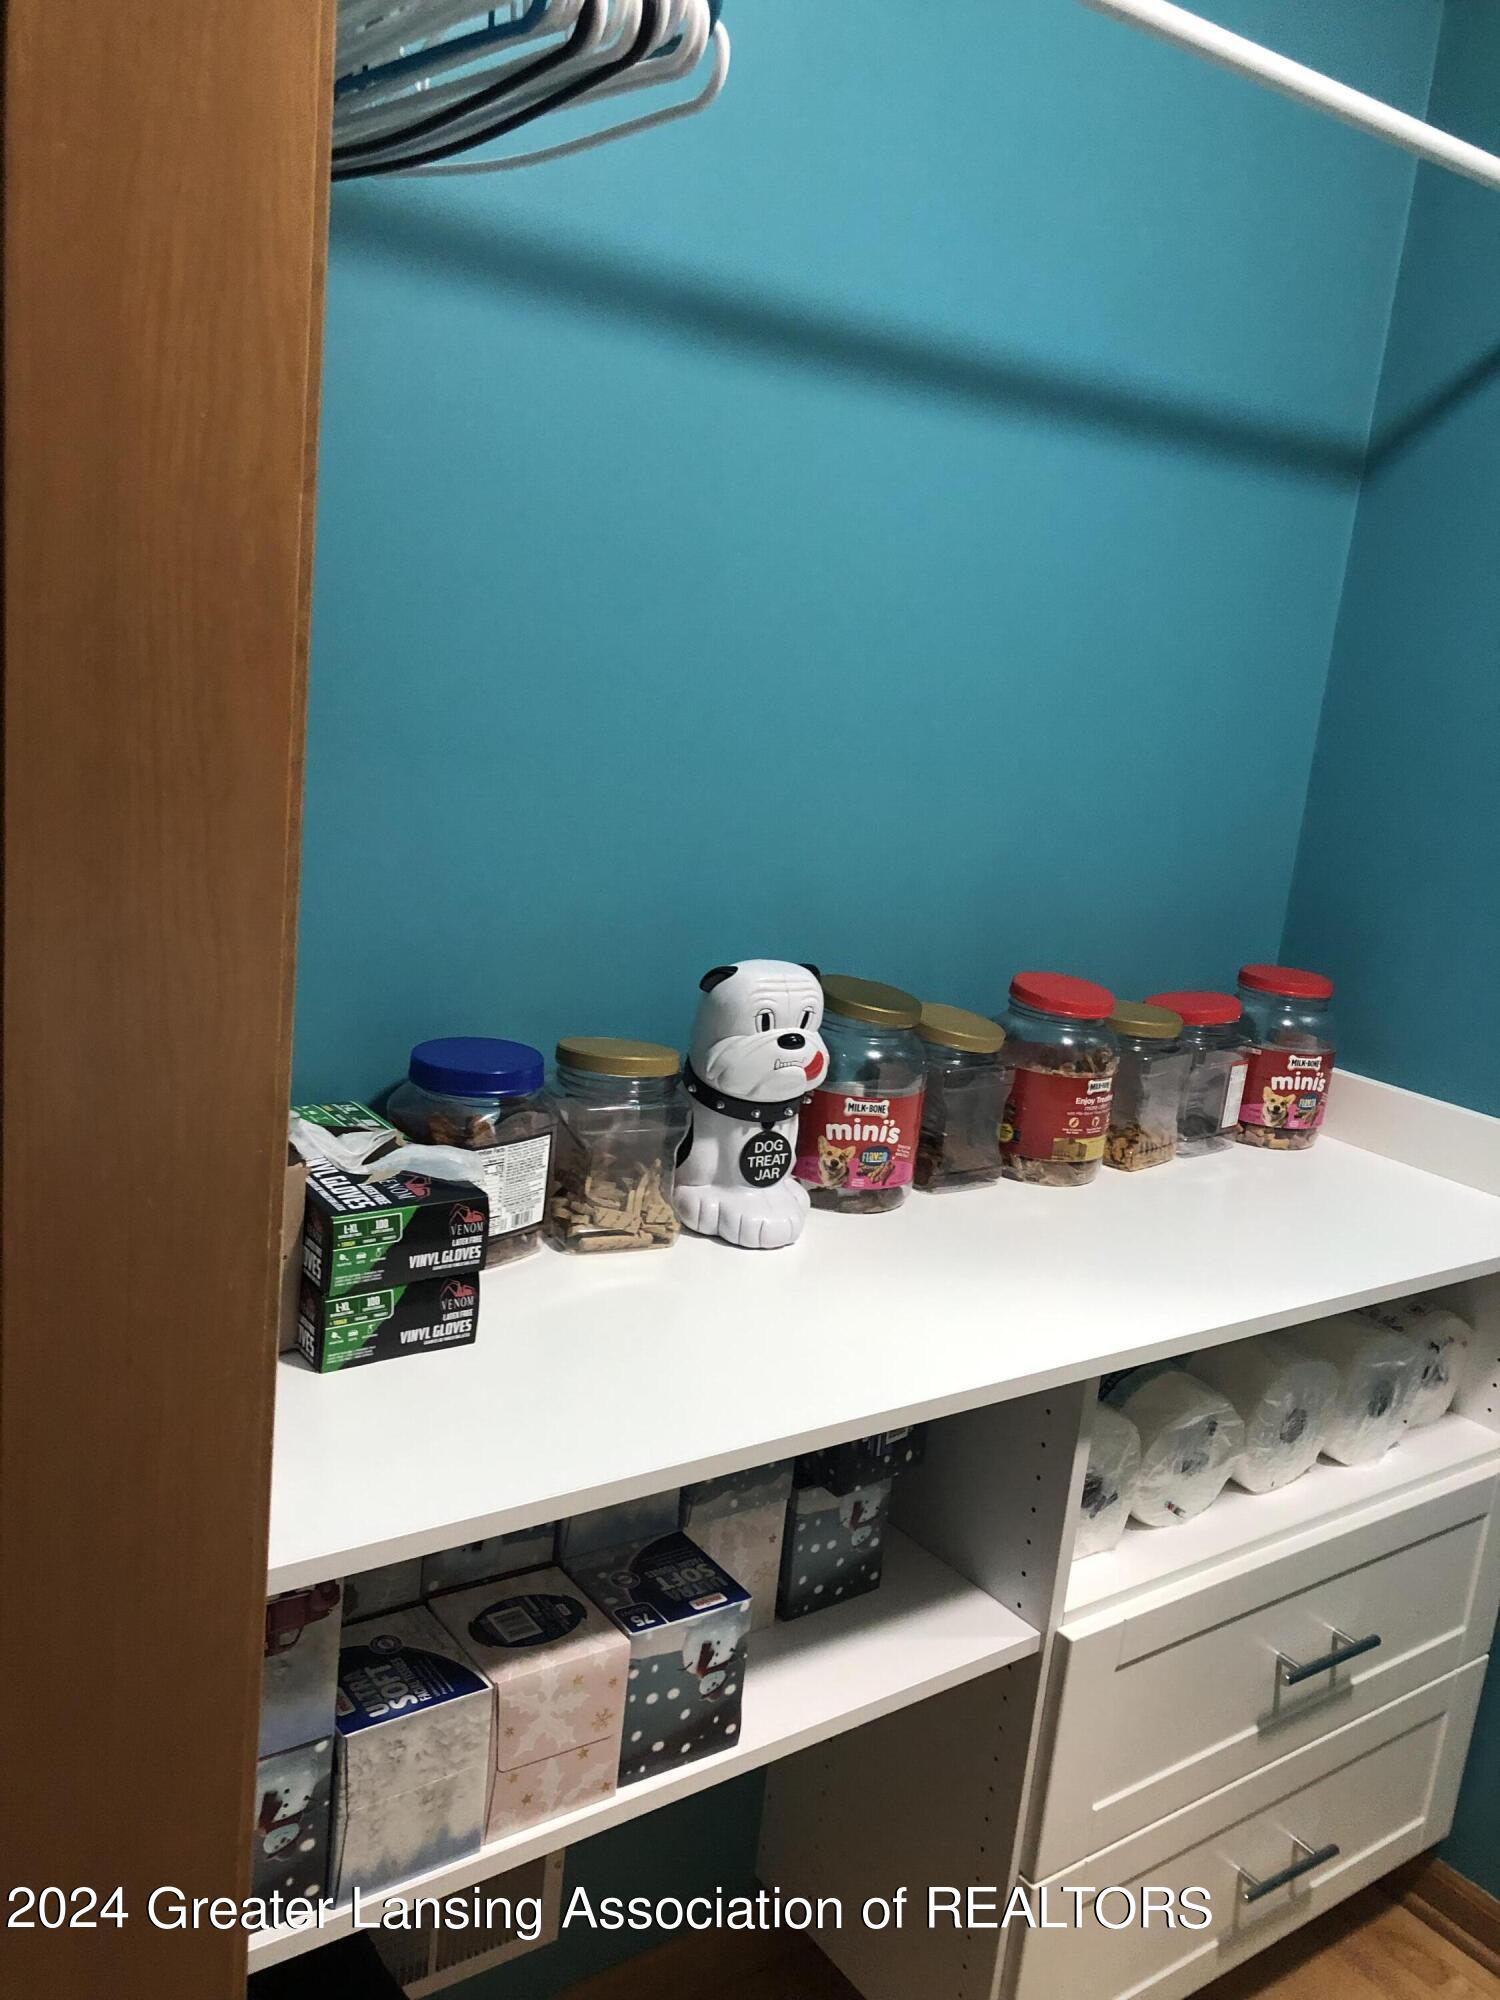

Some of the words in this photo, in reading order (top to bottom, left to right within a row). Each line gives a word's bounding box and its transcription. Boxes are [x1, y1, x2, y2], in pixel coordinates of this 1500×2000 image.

[1271, 1071, 1326, 1092] mini's
[847, 1103, 887, 1114] MILK-BONE
[1075, 1096, 1095, 1106] Enjoy
[825, 1118, 901, 1144] mini's
[754, 1139, 784, 1153] DOG
[747, 1153, 789, 1168] TREAT
[754, 1167, 780, 1181] JAR
[319, 1175, 377, 1210] GLOVES
[380, 1179, 416, 1200] ENOM
[450, 1222, 484, 1236] VENOM
[409, 1251, 440, 1269] VINYL
[441, 1245, 482, 1264] GLOVES
[441, 1295, 475, 1310] VENOM
[400, 1326, 431, 1345] VINYL
[432, 1319, 472, 1338] GLOVES
[656, 1563, 716, 1591] SOFT
[663, 1575, 729, 1602] ULTRA
[630, 1613, 656, 1627] 75
[342, 1669, 390, 1719] ULTRA
[364, 1664, 419, 1710] SOFT
